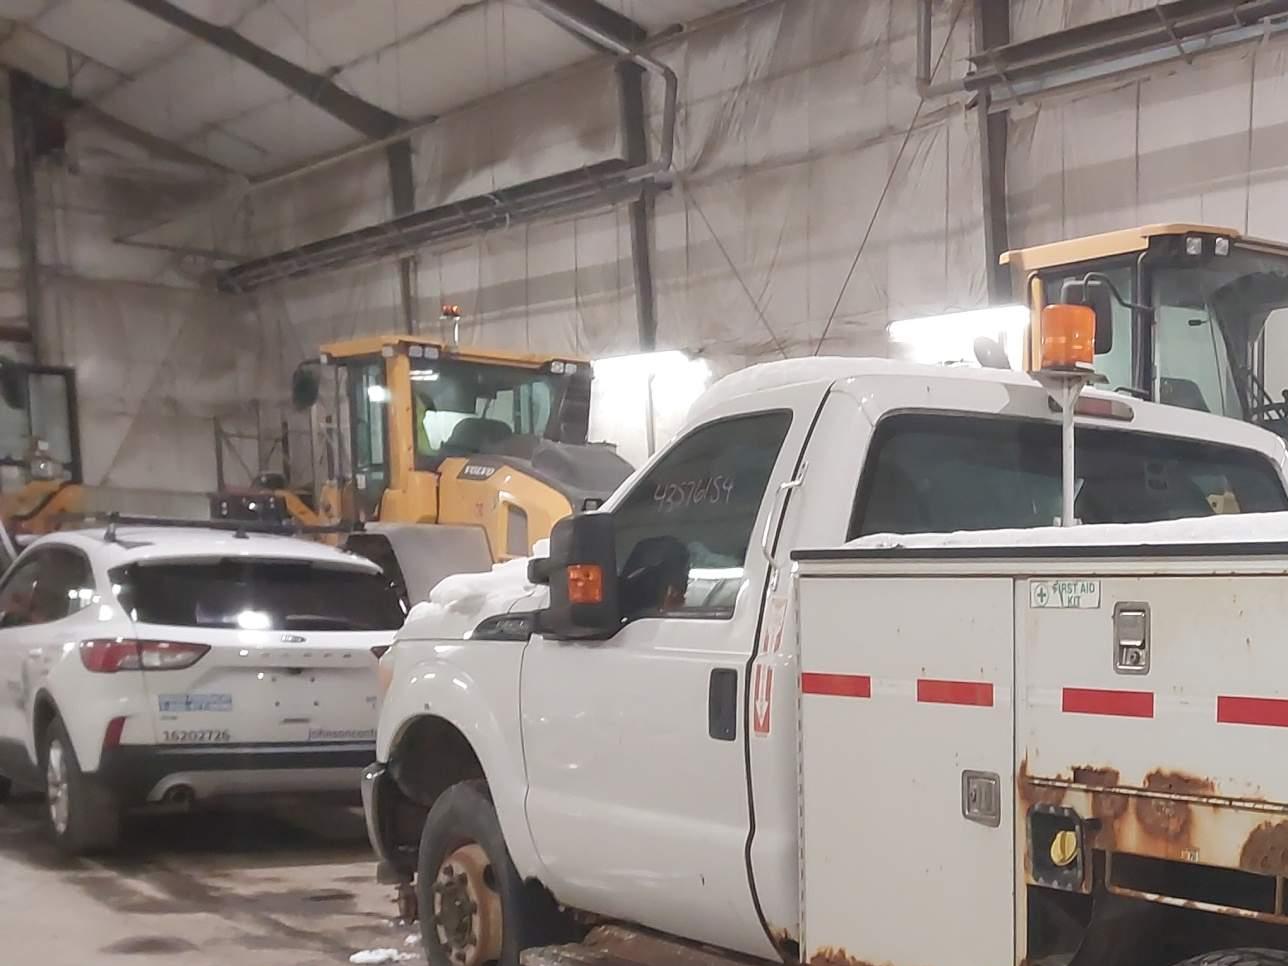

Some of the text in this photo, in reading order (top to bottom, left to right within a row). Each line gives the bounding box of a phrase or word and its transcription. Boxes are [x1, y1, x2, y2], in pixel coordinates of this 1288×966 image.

[464, 465, 495, 477] VOLVO
[654, 475, 733, 512] 43576154
[1080, 583, 1095, 593] AID
[1067, 595, 1081, 608] KIT
